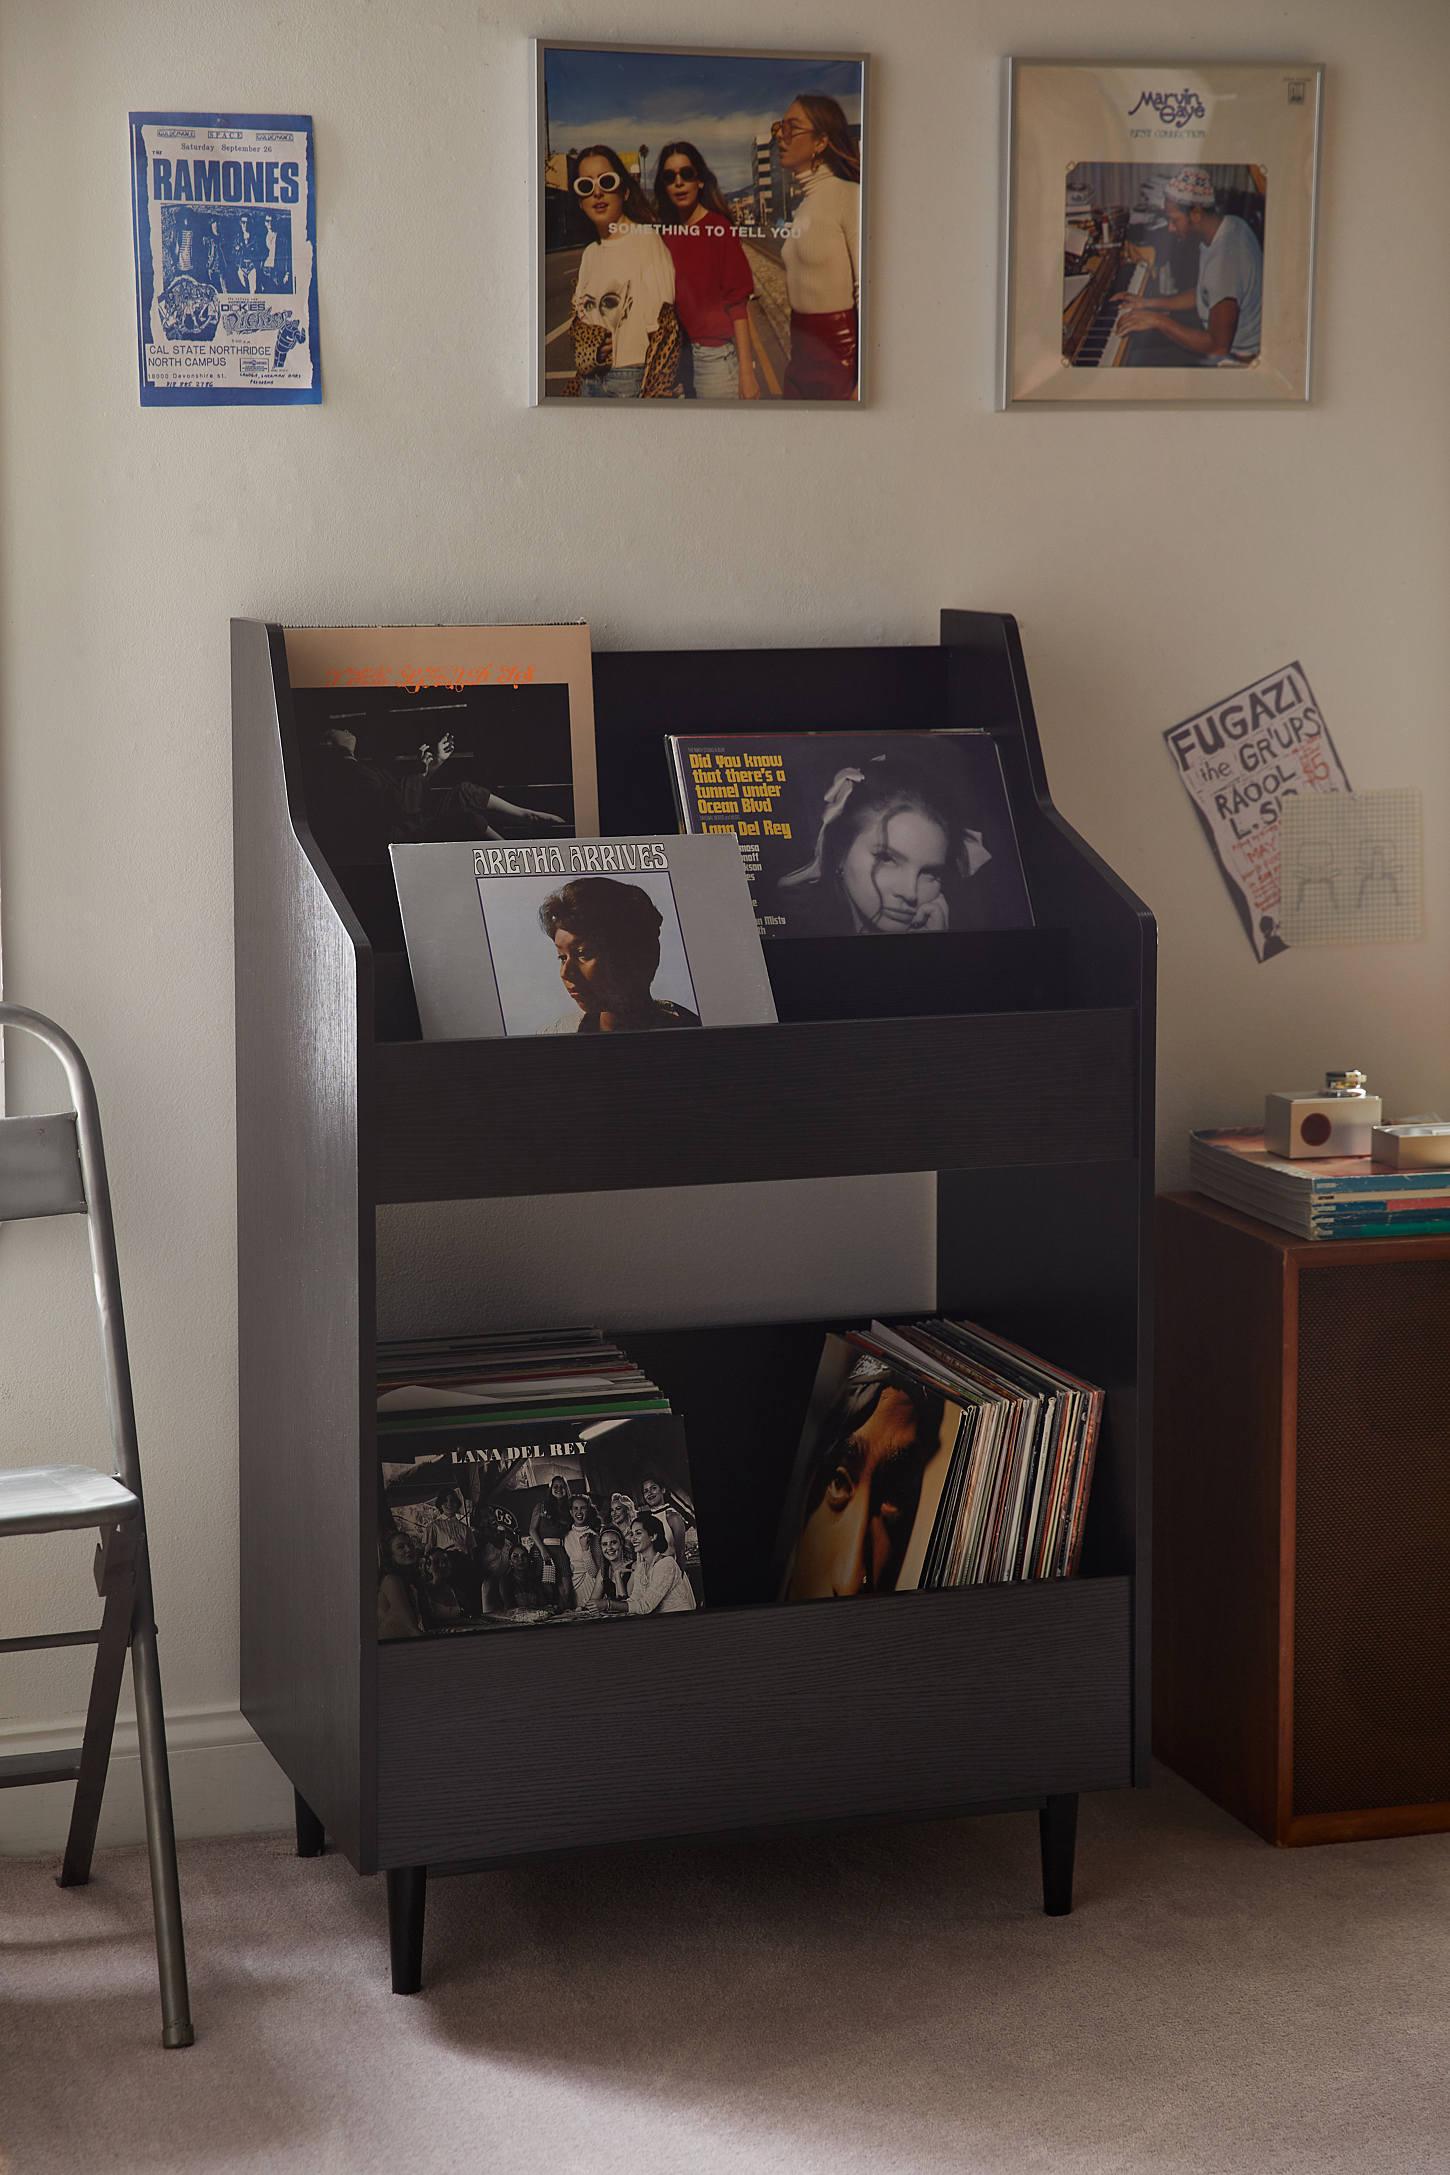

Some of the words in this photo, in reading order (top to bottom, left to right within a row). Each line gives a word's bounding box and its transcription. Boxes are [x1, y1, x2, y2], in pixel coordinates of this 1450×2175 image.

[1128, 88, 1202, 115] Marvin
[1160, 105, 1206, 128] Gaye
[181, 143, 214, 152] Saturday
[221, 144, 261, 153] September
[152, 158, 300, 204] RAMONES
[608, 222, 700, 237] SOMETHING
[704, 225, 725, 237] TO
[729, 226, 766, 239] TELL
[770, 228, 801, 240] YOU
[150, 345, 169, 355] CAL
[172, 345, 206, 355] STATE
[209, 346, 271, 356] NORTHRIDGE
[148, 357, 182, 367] NORTH
[185, 357, 227, 367] CAMPUS
[1171, 674, 1303, 772] FUGAZI
[689, 753, 712, 768] Did
[743, 753, 783, 768] know
[692, 768, 722, 784] that
[725, 767, 773, 783] there's
[776, 769, 786, 782] a
[1200, 760, 1233, 782] the
[695, 783, 739, 798] tunnel
[742, 782, 781, 797] under
[1214, 764, 1296, 820] RAOOL
[697, 799, 739, 814] Ocean
[741, 797, 772, 813] Blvd
[737, 820, 760, 836] Del
[763, 819, 792, 839] Rey
[473, 845, 565, 876] ARETHA
[569, 842, 669, 872] ARRIVES
[451, 1448, 502, 1464] LANA
[507, 1445, 545, 1461] DEL
[550, 1441, 588, 1457] REY
